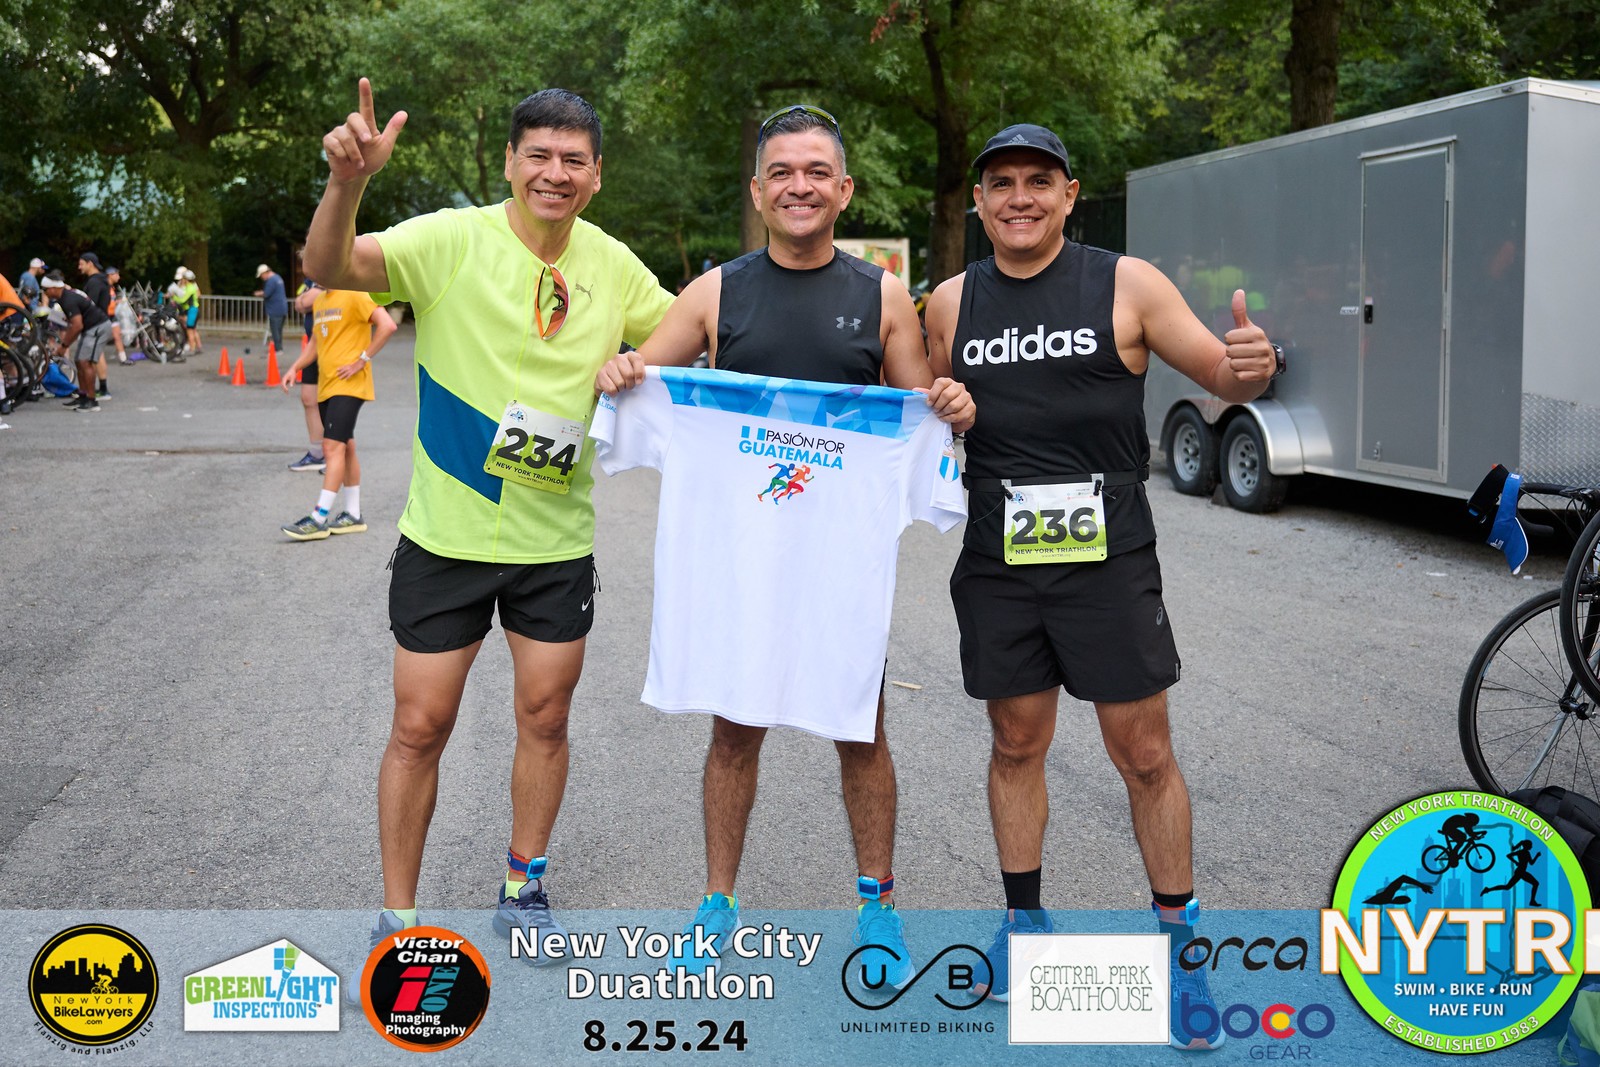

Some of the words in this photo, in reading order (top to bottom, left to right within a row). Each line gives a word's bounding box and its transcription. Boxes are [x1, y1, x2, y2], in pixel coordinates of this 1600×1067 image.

[963, 324, 1098, 366] adidas
[495, 427, 576, 476] 234
[738, 440, 843, 470] GUATEMALA
[766, 430, 815, 449] PASIÓN
[816, 438, 845, 455] POR
[495, 461, 512, 471] NEW
[513, 468, 531, 477] YORK
[533, 472, 565, 486] TRIATHLON
[1011, 507, 1098, 545] 236
[1056, 546, 1097, 554] TRIATHLON
